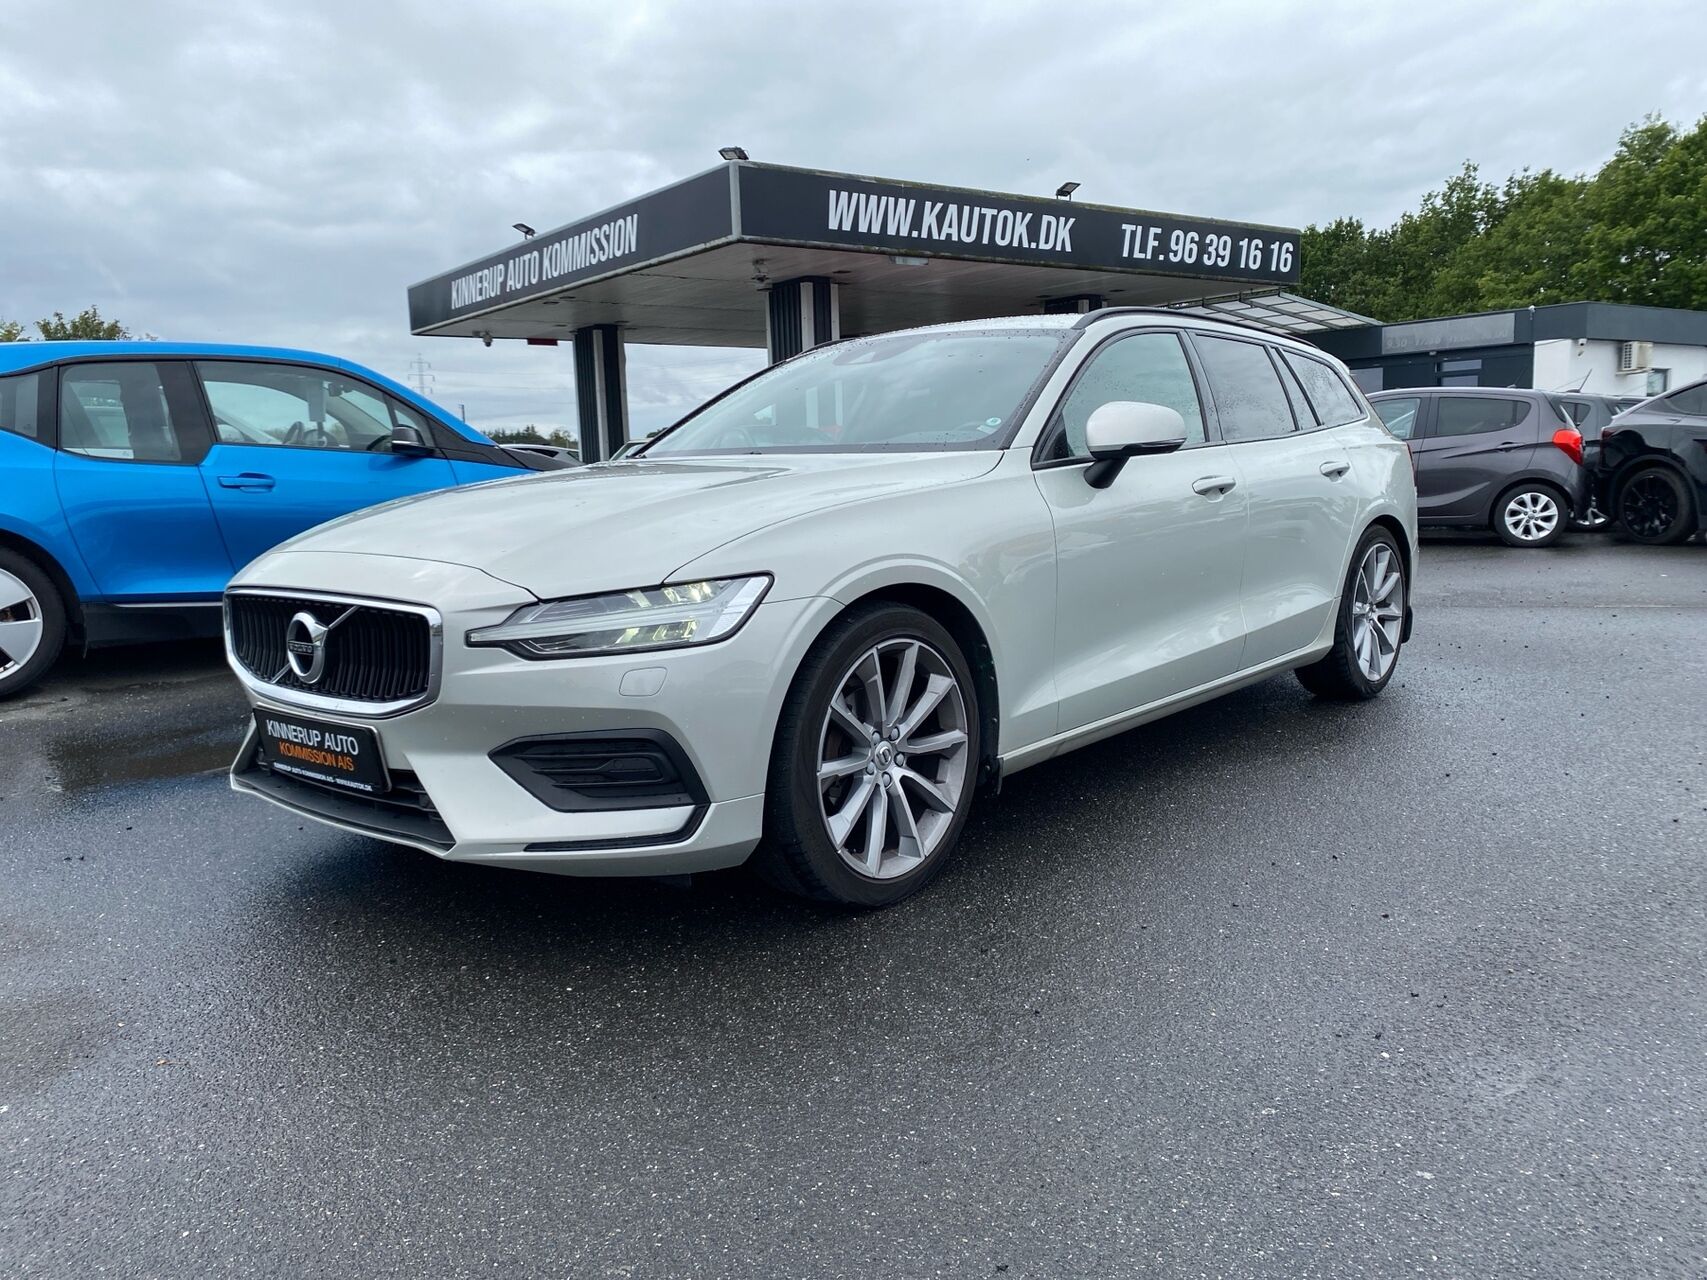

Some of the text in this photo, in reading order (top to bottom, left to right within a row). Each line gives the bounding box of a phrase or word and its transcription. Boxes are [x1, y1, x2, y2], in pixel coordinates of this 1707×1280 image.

[828, 190, 1076, 252] WWW.KAUTOK.DK
[452, 214, 638, 309] KINNERUP AUTO KOMMISSION
[1121, 223, 1293, 273] TLF. 96 39 16 16
[267, 719, 359, 755] KINNERUP AUTO
[279, 741, 354, 771] KOMMISSION A/S
